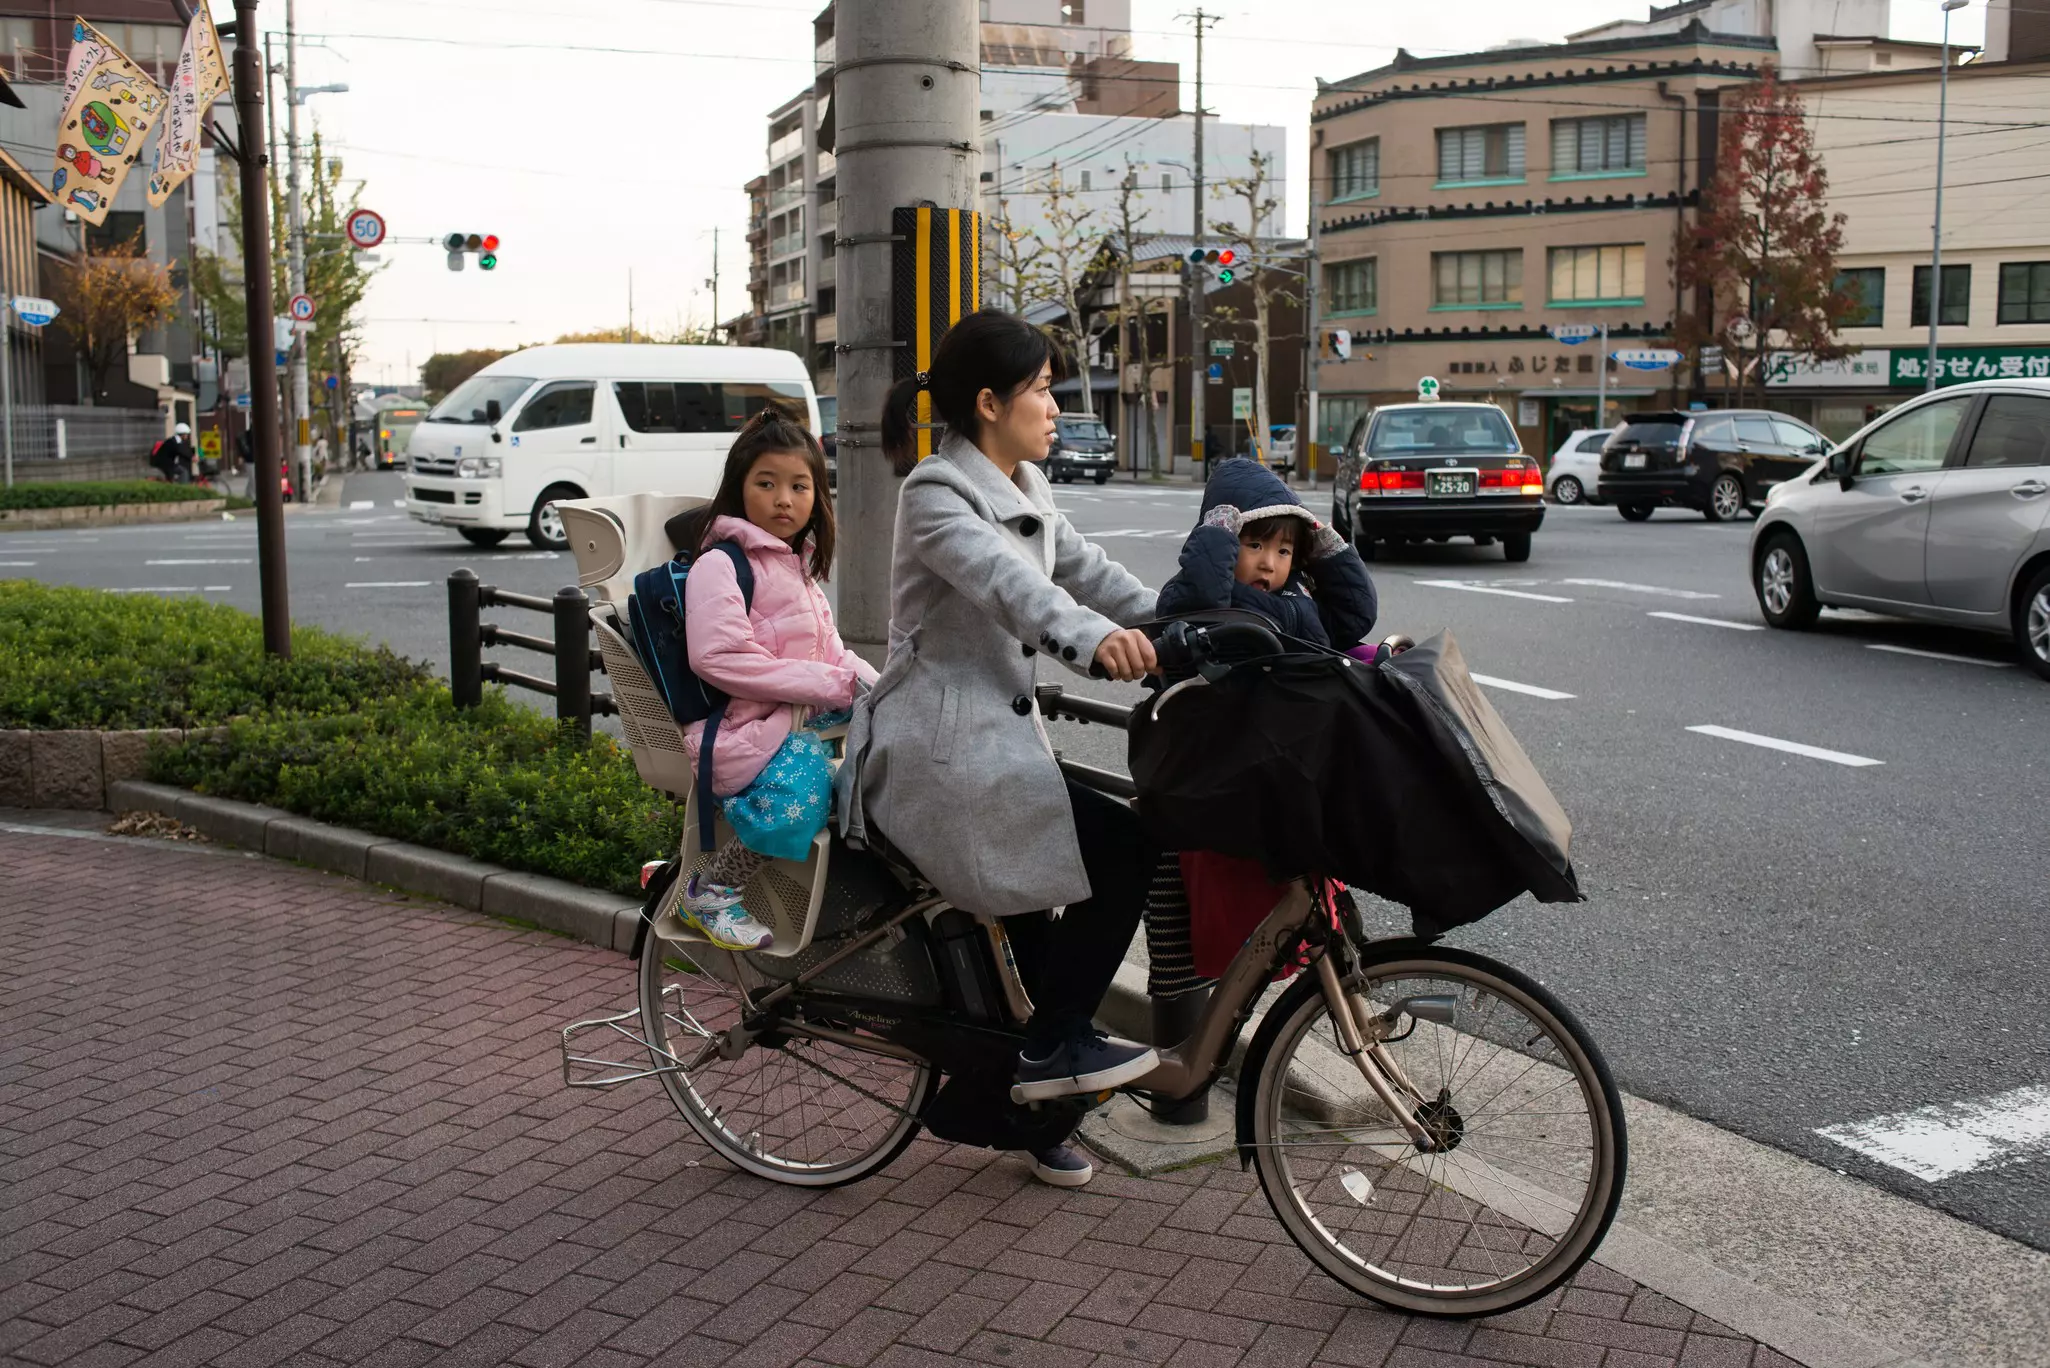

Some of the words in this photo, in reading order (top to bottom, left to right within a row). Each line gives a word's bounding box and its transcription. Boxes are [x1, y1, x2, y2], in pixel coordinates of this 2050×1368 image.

[355, 219, 378, 238] 50
[1896, 356, 2050, 378] 処方せん受付
[848, 1010, 897, 1026] Angelino
